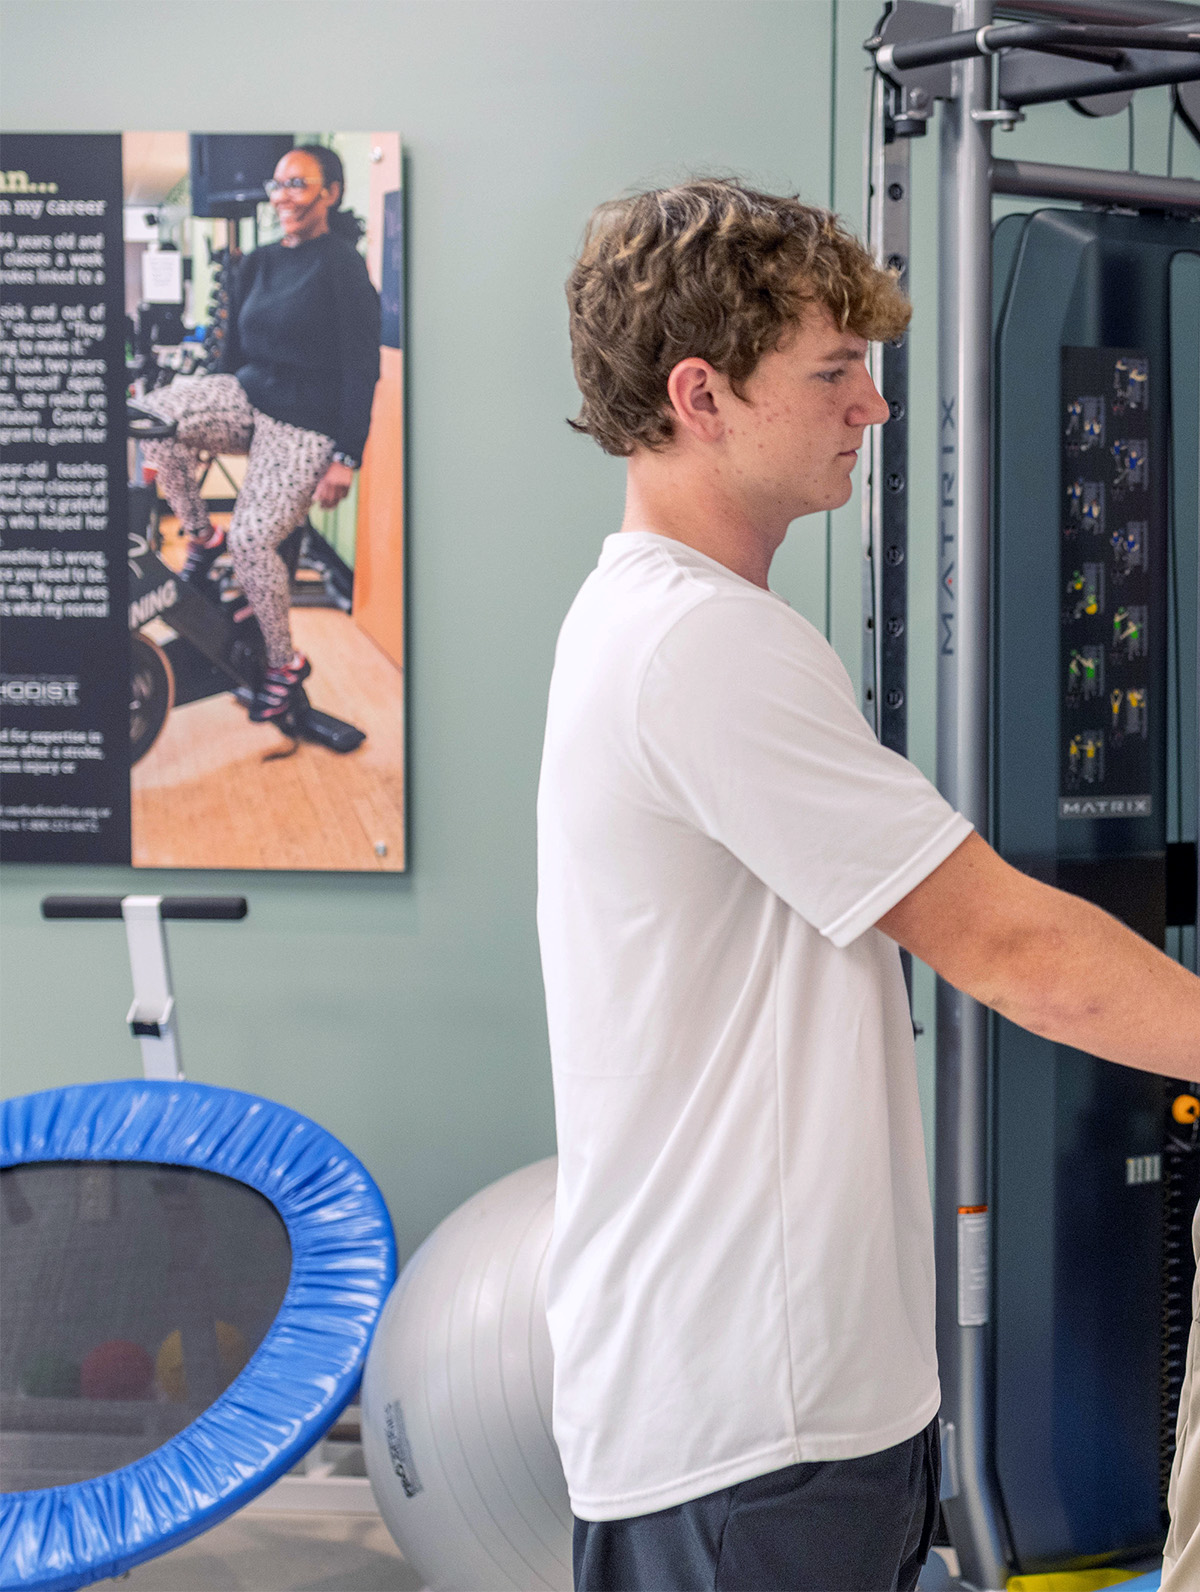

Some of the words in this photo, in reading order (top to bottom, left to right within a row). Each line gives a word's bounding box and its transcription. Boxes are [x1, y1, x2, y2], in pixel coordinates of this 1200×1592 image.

[0, 170, 58, 194] n...
[13, 200, 44, 220] my
[46, 200, 107, 216] career
[16, 235, 53, 252] years
[54, 232, 76, 250] old
[78, 232, 105, 250] and
[69, 251, 105, 268] week
[36, 268, 76, 285] linked
[78, 269, 93, 285] to
[94, 270, 105, 285] a
[31, 303, 58, 321] and
[61, 304, 85, 321] out
[89, 303, 106, 321] of
[19, 340, 34, 356] to
[88, 394, 108, 409] on
[32, 427, 47, 443] to
[84, 427, 107, 444] her
[56, 461, 109, 479] teaches
[85, 514, 108, 530] her
[941, 396, 955, 655] MATRIX
[64, 601, 110, 618] normal
[1063, 799, 1148, 815] MATRIX
